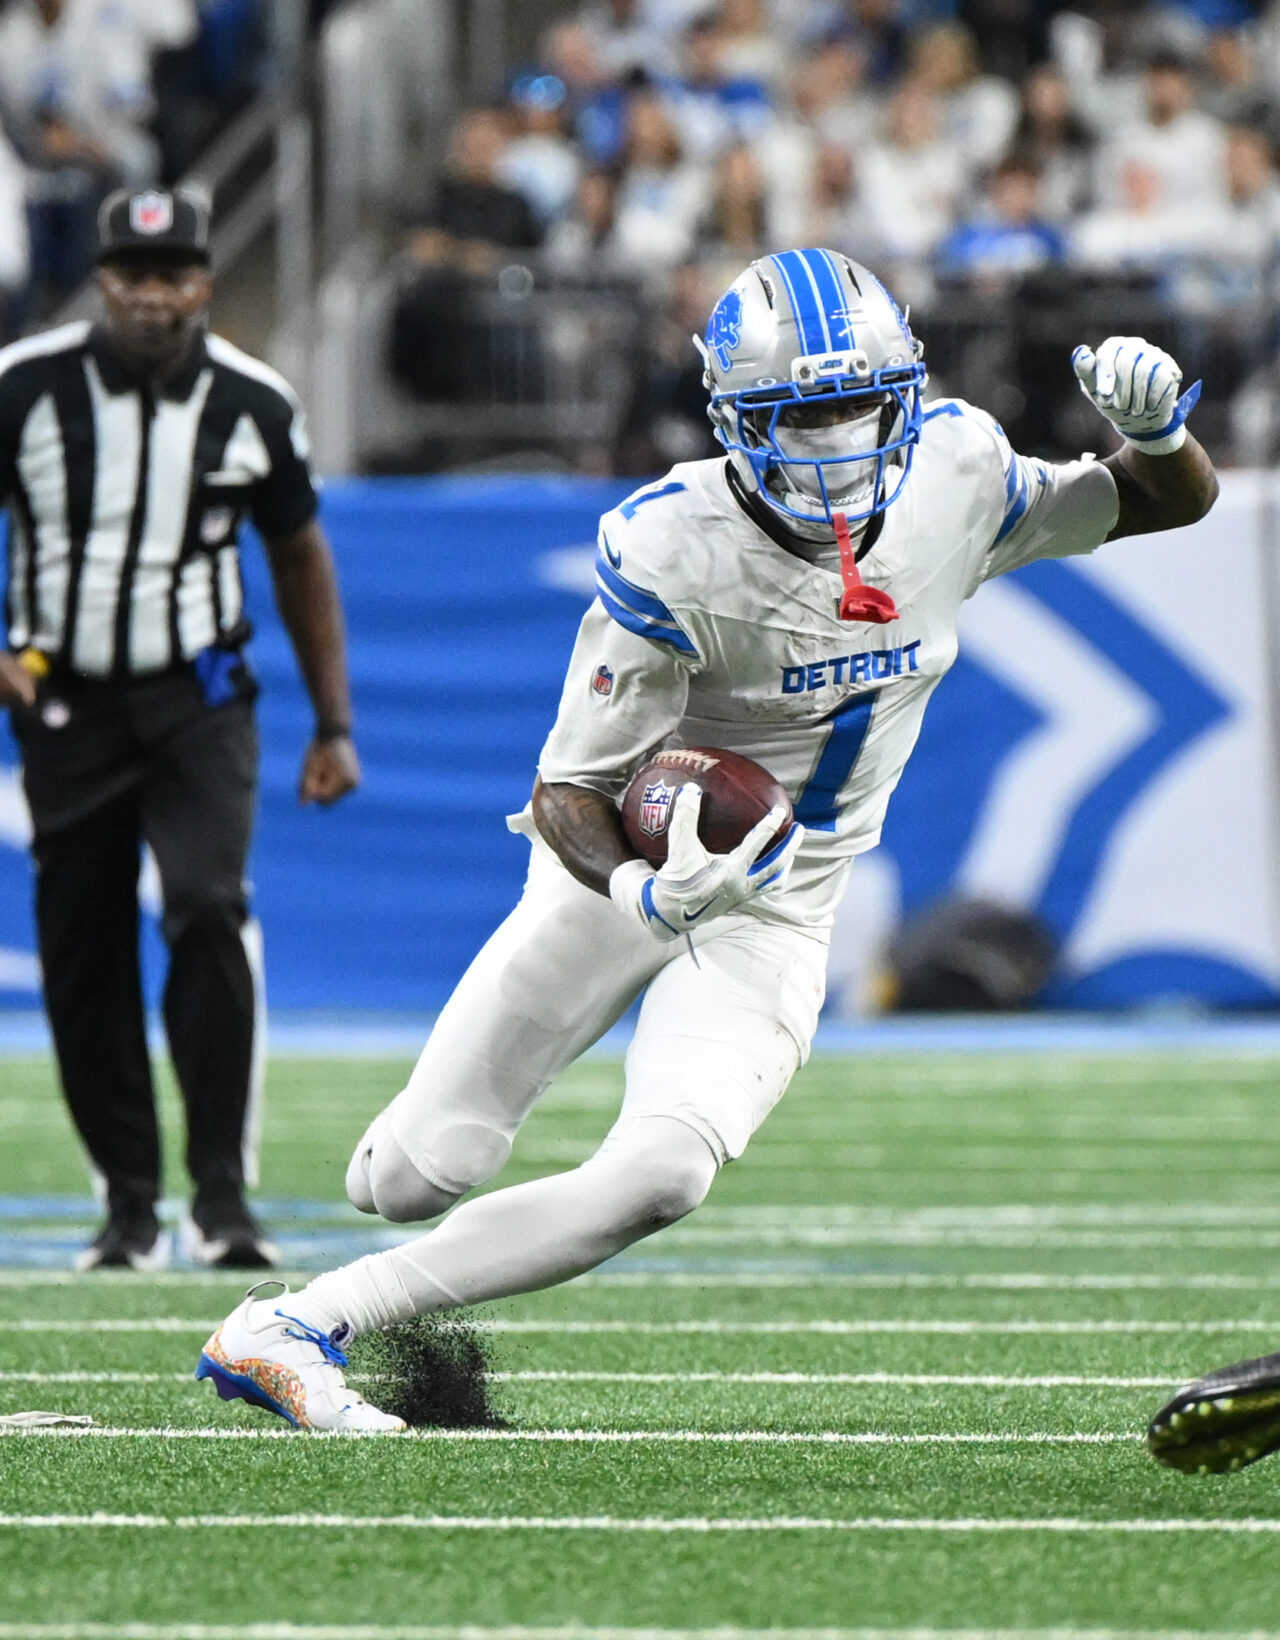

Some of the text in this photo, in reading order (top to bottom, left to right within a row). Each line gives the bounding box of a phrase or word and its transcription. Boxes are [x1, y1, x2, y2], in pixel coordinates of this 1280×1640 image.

[619, 481, 689, 521] 1
[780, 638, 922, 694] DETROIT
[791, 686, 883, 834] 1
[642, 804, 665, 830] NFL
